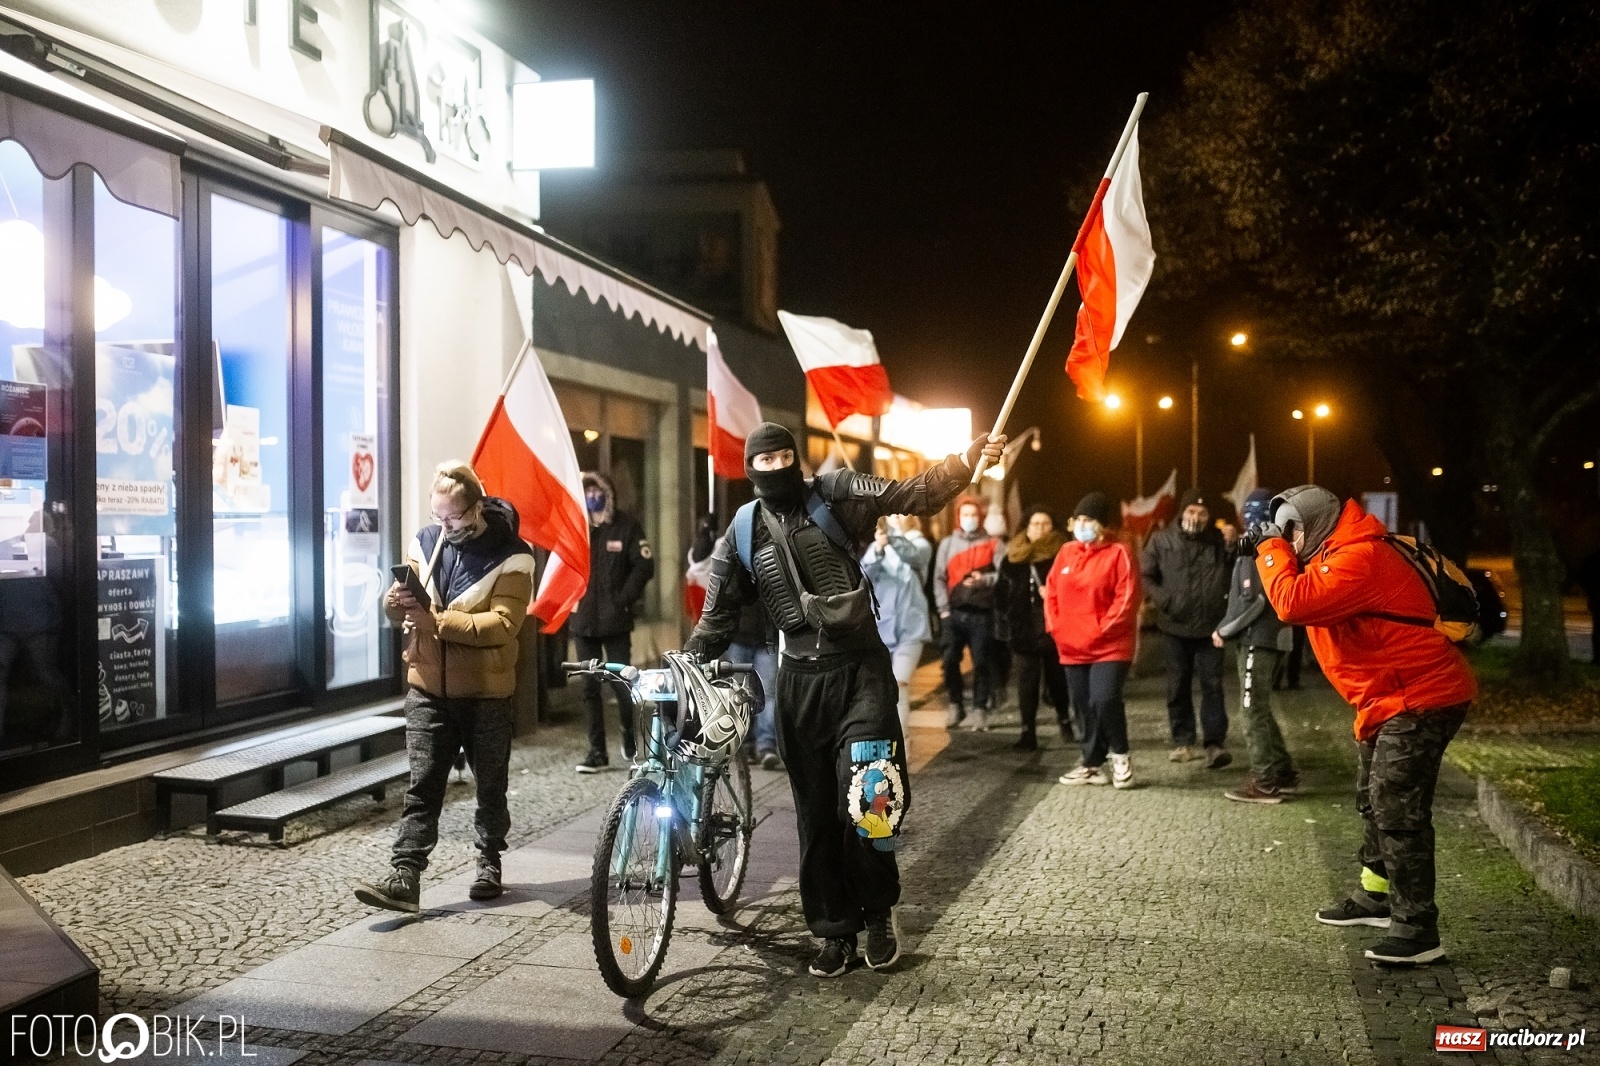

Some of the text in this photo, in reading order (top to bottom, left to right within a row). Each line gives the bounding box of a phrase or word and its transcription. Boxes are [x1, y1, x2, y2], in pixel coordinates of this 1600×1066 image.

[97, 482, 165, 495] eny z nieba spadły!
[107, 496, 123, 504] teraz
[140, 497, 165, 505] RABATU
[108, 586, 133, 597] oferta
